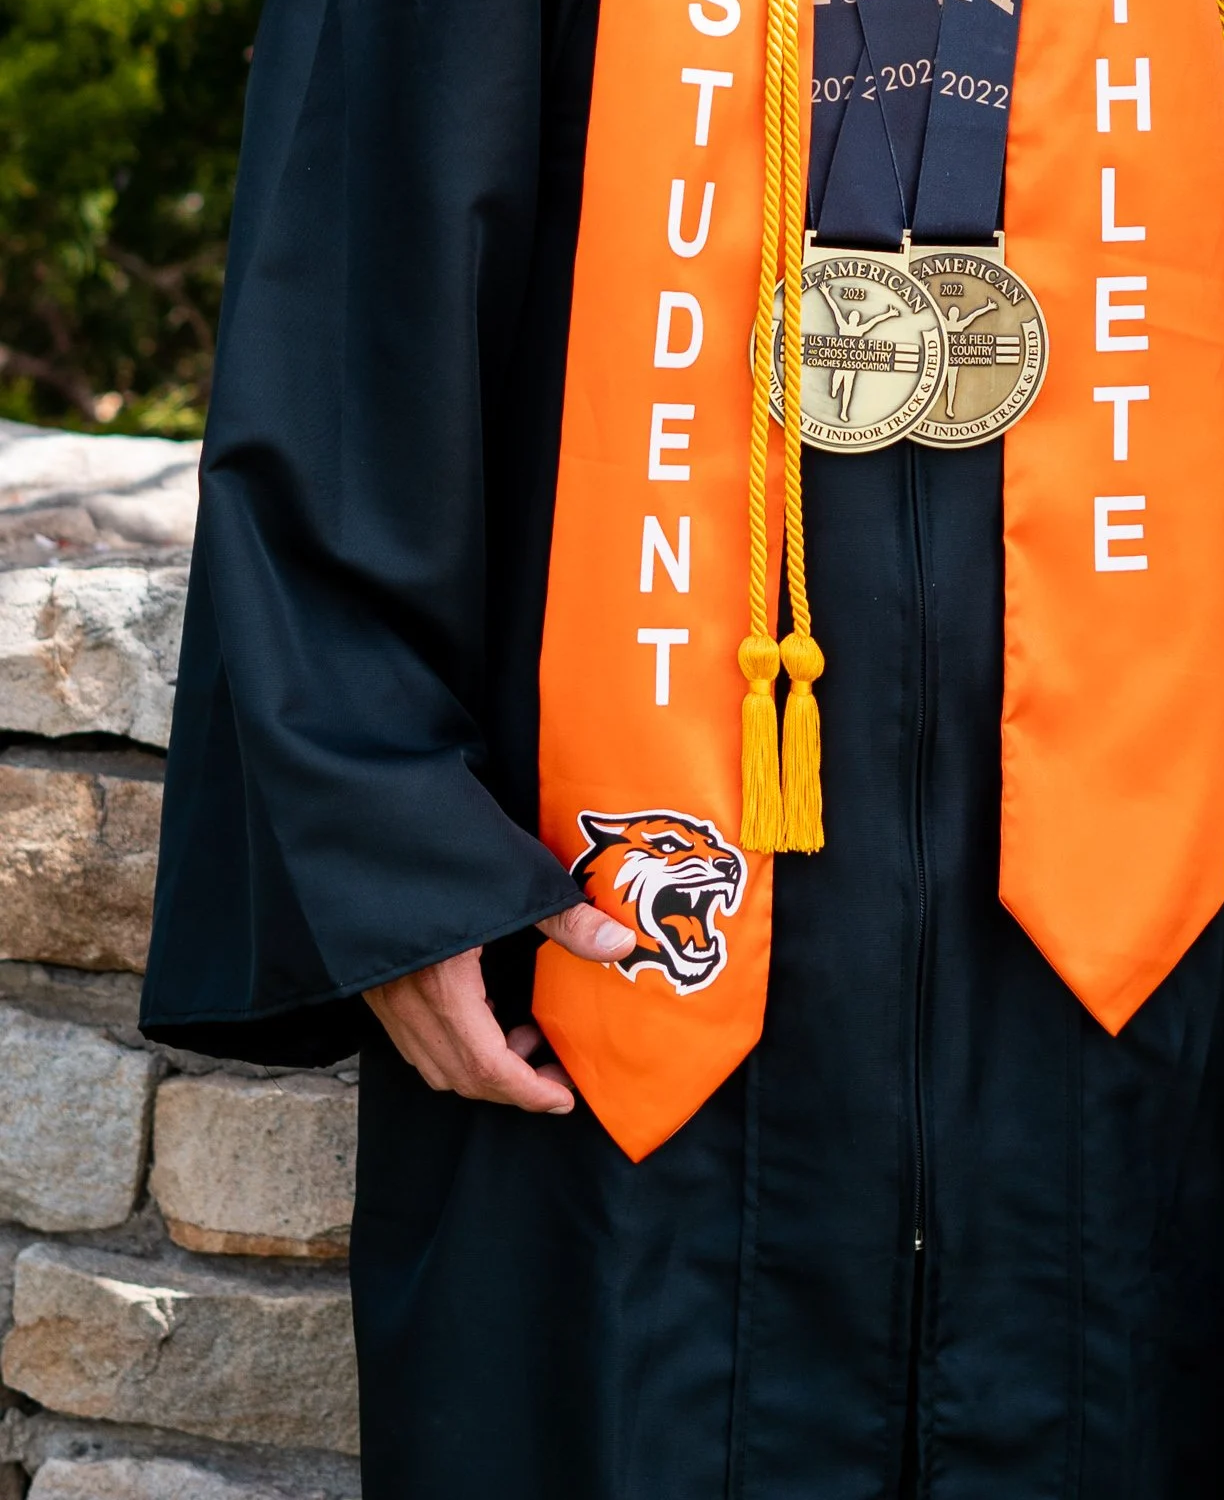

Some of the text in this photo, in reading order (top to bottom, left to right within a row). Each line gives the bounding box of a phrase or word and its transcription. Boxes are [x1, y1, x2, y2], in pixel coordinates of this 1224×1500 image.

[881, 59, 933, 92] 202
[939, 71, 1009, 109] 2022
[801, 261, 928, 314] L-AMERICAN
[842, 288, 865, 300] 2023
[941, 284, 964, 296] 2022
[809, 335, 893, 352] U.S. TRACK & FIELD
[959, 334, 967, 345] &
[969, 334, 994, 345] FIELD
[818, 348, 847, 359] CROSS
[849, 350, 892, 363] COUNTRY
[951, 345, 993, 356] COUNTRY
[1027, 330, 1039, 369] FIELD
[807, 357, 891, 372] COACHES ASSOCIATION
[925, 339, 938, 379] FIELD
[948, 356, 992, 365] SSOCIATION
[1023, 373, 1034, 384] &
[920, 382, 932, 393] &
[884, 394, 925, 431] TRACK
[990, 385, 1028, 424] TRACK
[807, 419, 824, 436] III
[826, 426, 884, 442] INDOOR
[934, 421, 990, 438] INDOOR
